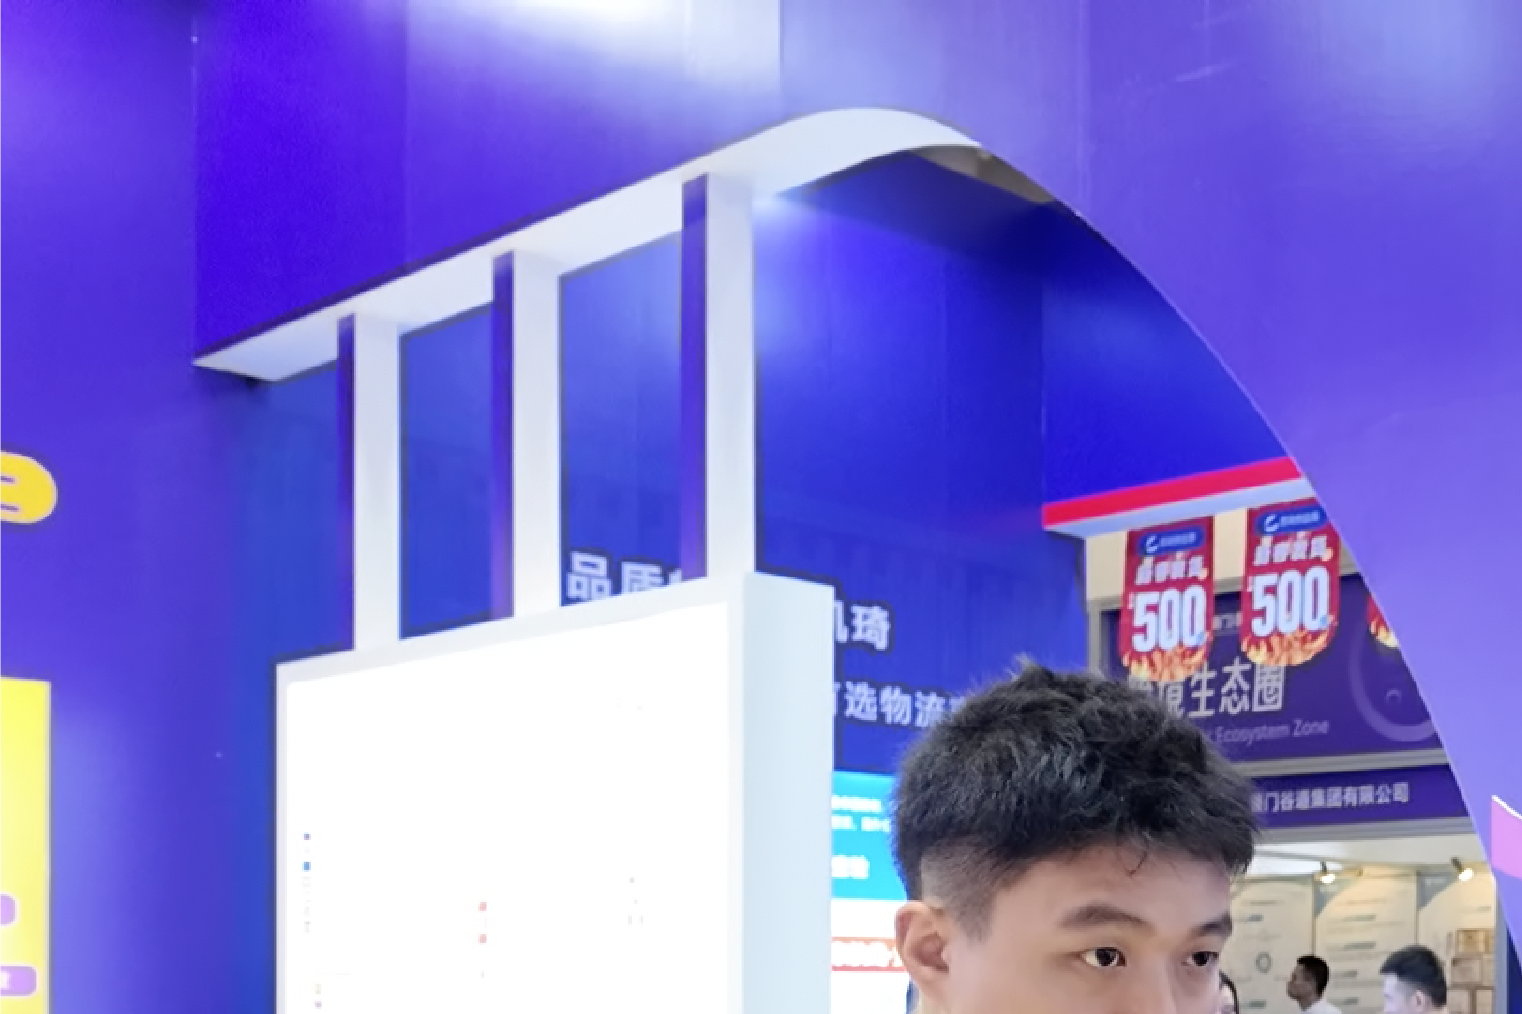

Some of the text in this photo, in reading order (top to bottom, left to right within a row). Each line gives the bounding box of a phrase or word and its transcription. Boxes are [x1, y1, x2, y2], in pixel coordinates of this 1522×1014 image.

[566, 550, 682, 601] 品质
[1131, 584, 1207, 652] 500
[1251, 566, 1330, 637] 500
[834, 680, 966, 728] 选物流
[1215, 718, 1330, 747] Ecosystem Zone
